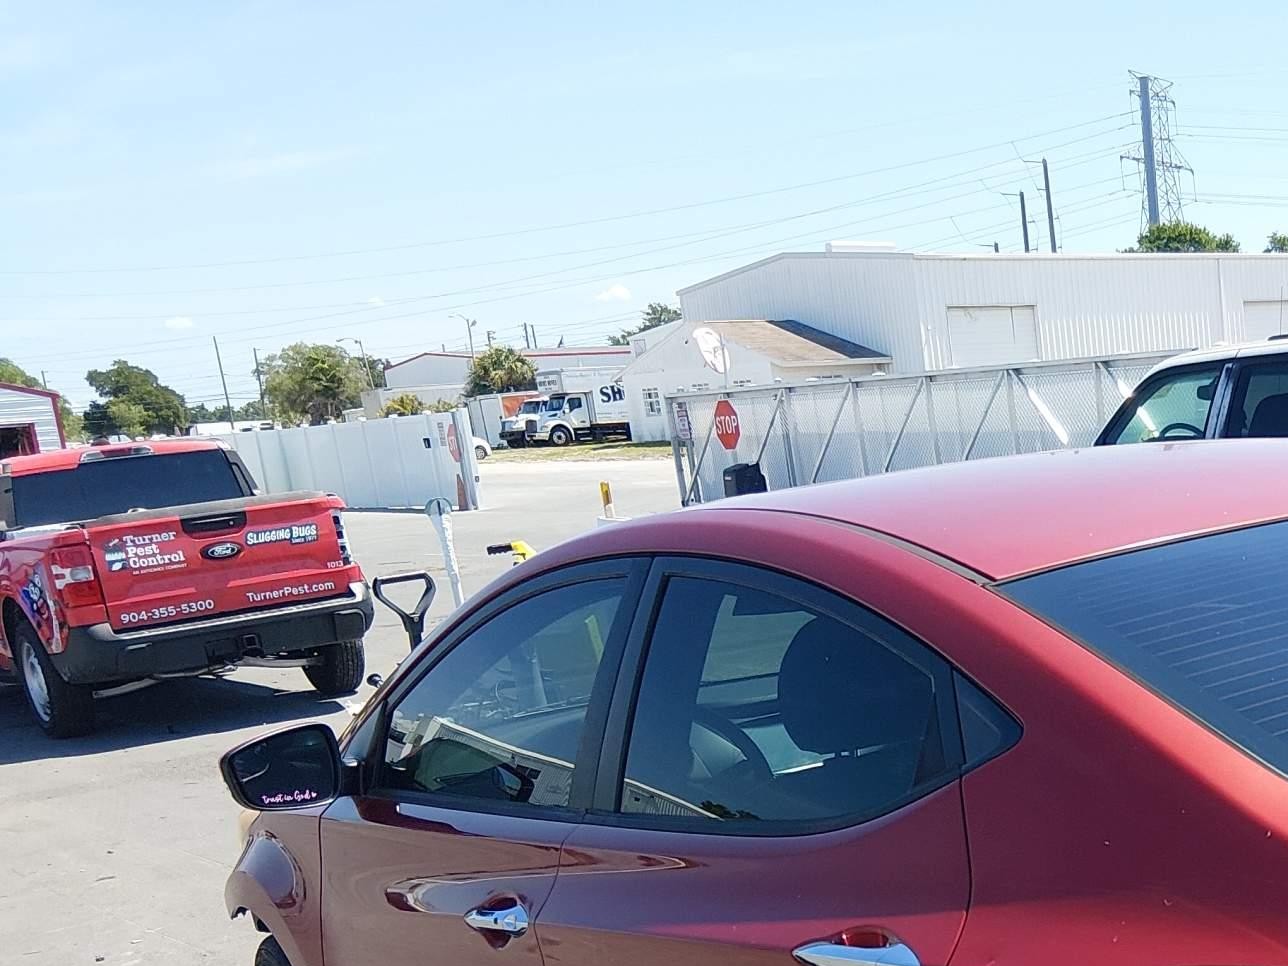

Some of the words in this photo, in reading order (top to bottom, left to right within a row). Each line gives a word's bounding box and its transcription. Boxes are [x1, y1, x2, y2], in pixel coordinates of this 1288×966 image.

[600, 383, 626, 403] SH
[716, 416, 738, 434] STOP
[122, 531, 177, 546] Turner
[246, 528, 291, 544] SLUGGING
[291, 524, 317, 538] BUGS
[126, 543, 160, 558] Pest
[129, 550, 185, 569] Control
[326, 560, 344, 569] 1013
[246, 581, 335, 602] TurnerPest.com
[120, 600, 214, 624] 904-355-5300
